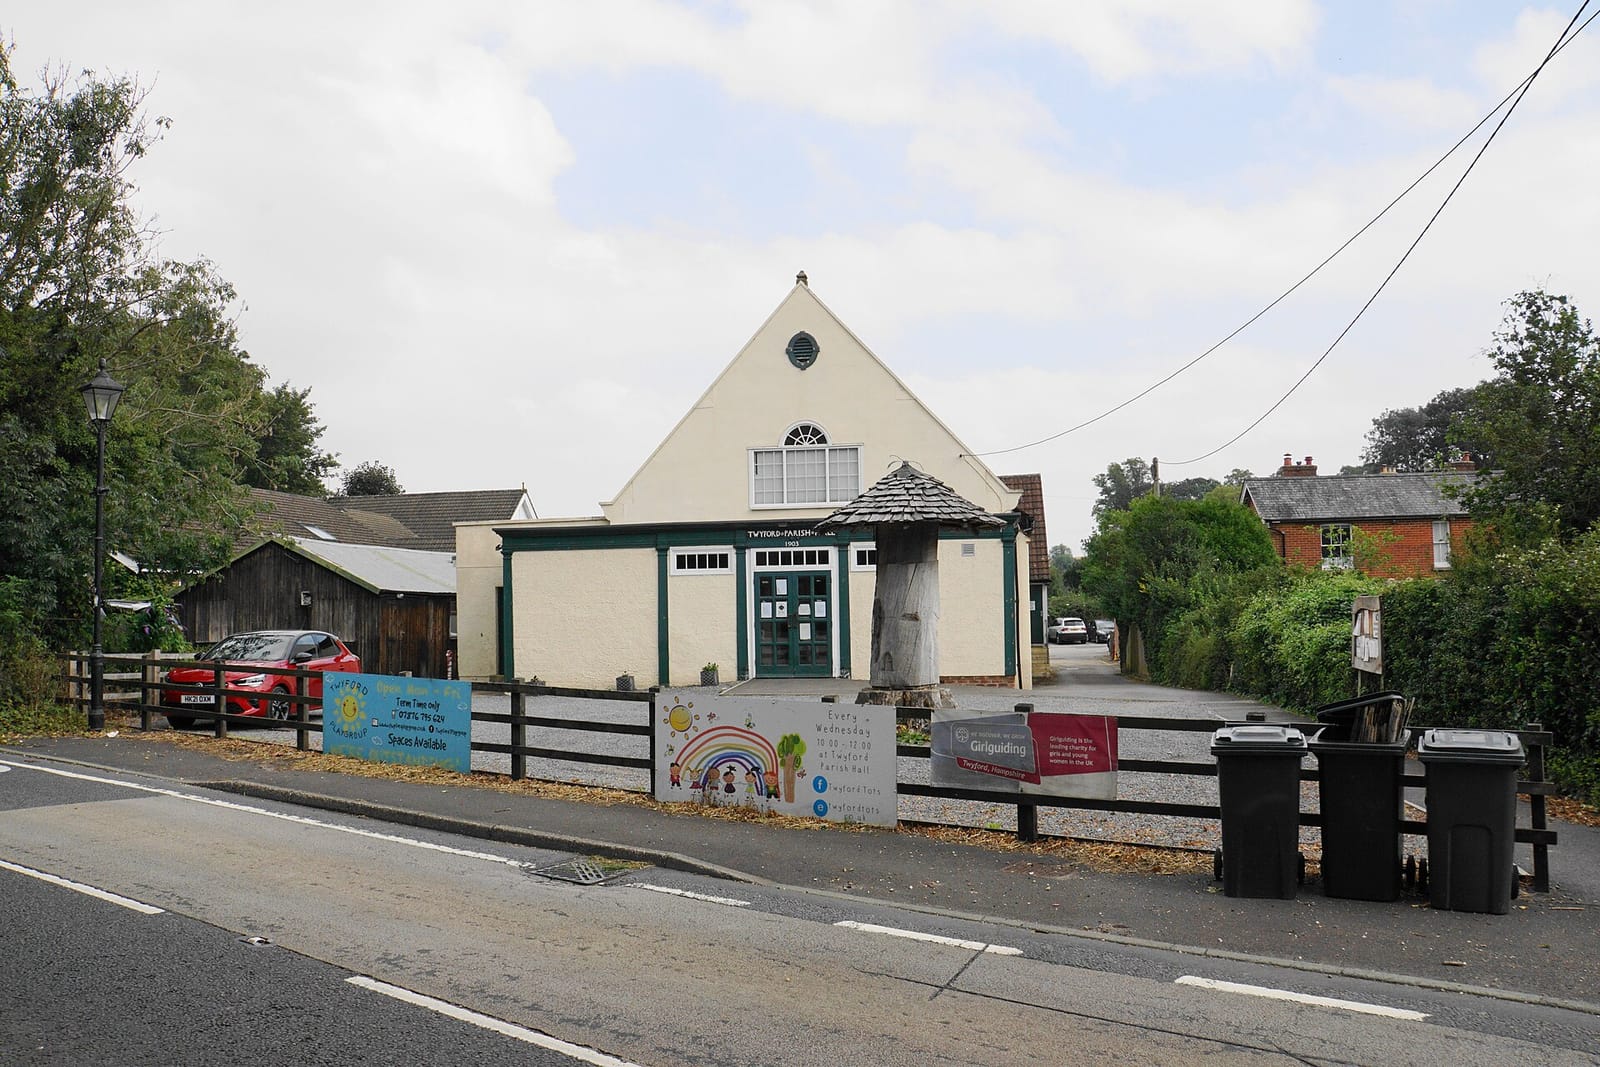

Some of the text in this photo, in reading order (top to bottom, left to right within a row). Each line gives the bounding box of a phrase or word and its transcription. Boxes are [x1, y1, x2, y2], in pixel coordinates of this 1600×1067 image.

[747, 530, 781, 538] TWYFORD
[784, 529, 811, 537] PARISH
[330, 680, 368, 696] TWYFORD
[396, 697, 411, 709] Term
[412, 699, 427, 710] Time
[828, 710, 857, 723] Every
[329, 721, 368, 739] PLAYGROUP
[816, 723, 870, 738] Wednesday
[388, 733, 447, 751] Spaces Available
[1049, 735, 1077, 744] Girlguiding
[970, 740, 1026, 758] Girlguiding
[1049, 743, 1068, 751] leading
[1069, 744, 1087, 752] charity
[832, 750, 869, 761] Twyford
[820, 761, 870, 774] Parish Hall
[962, 759, 1026, 779] Twyford, Hampshire
